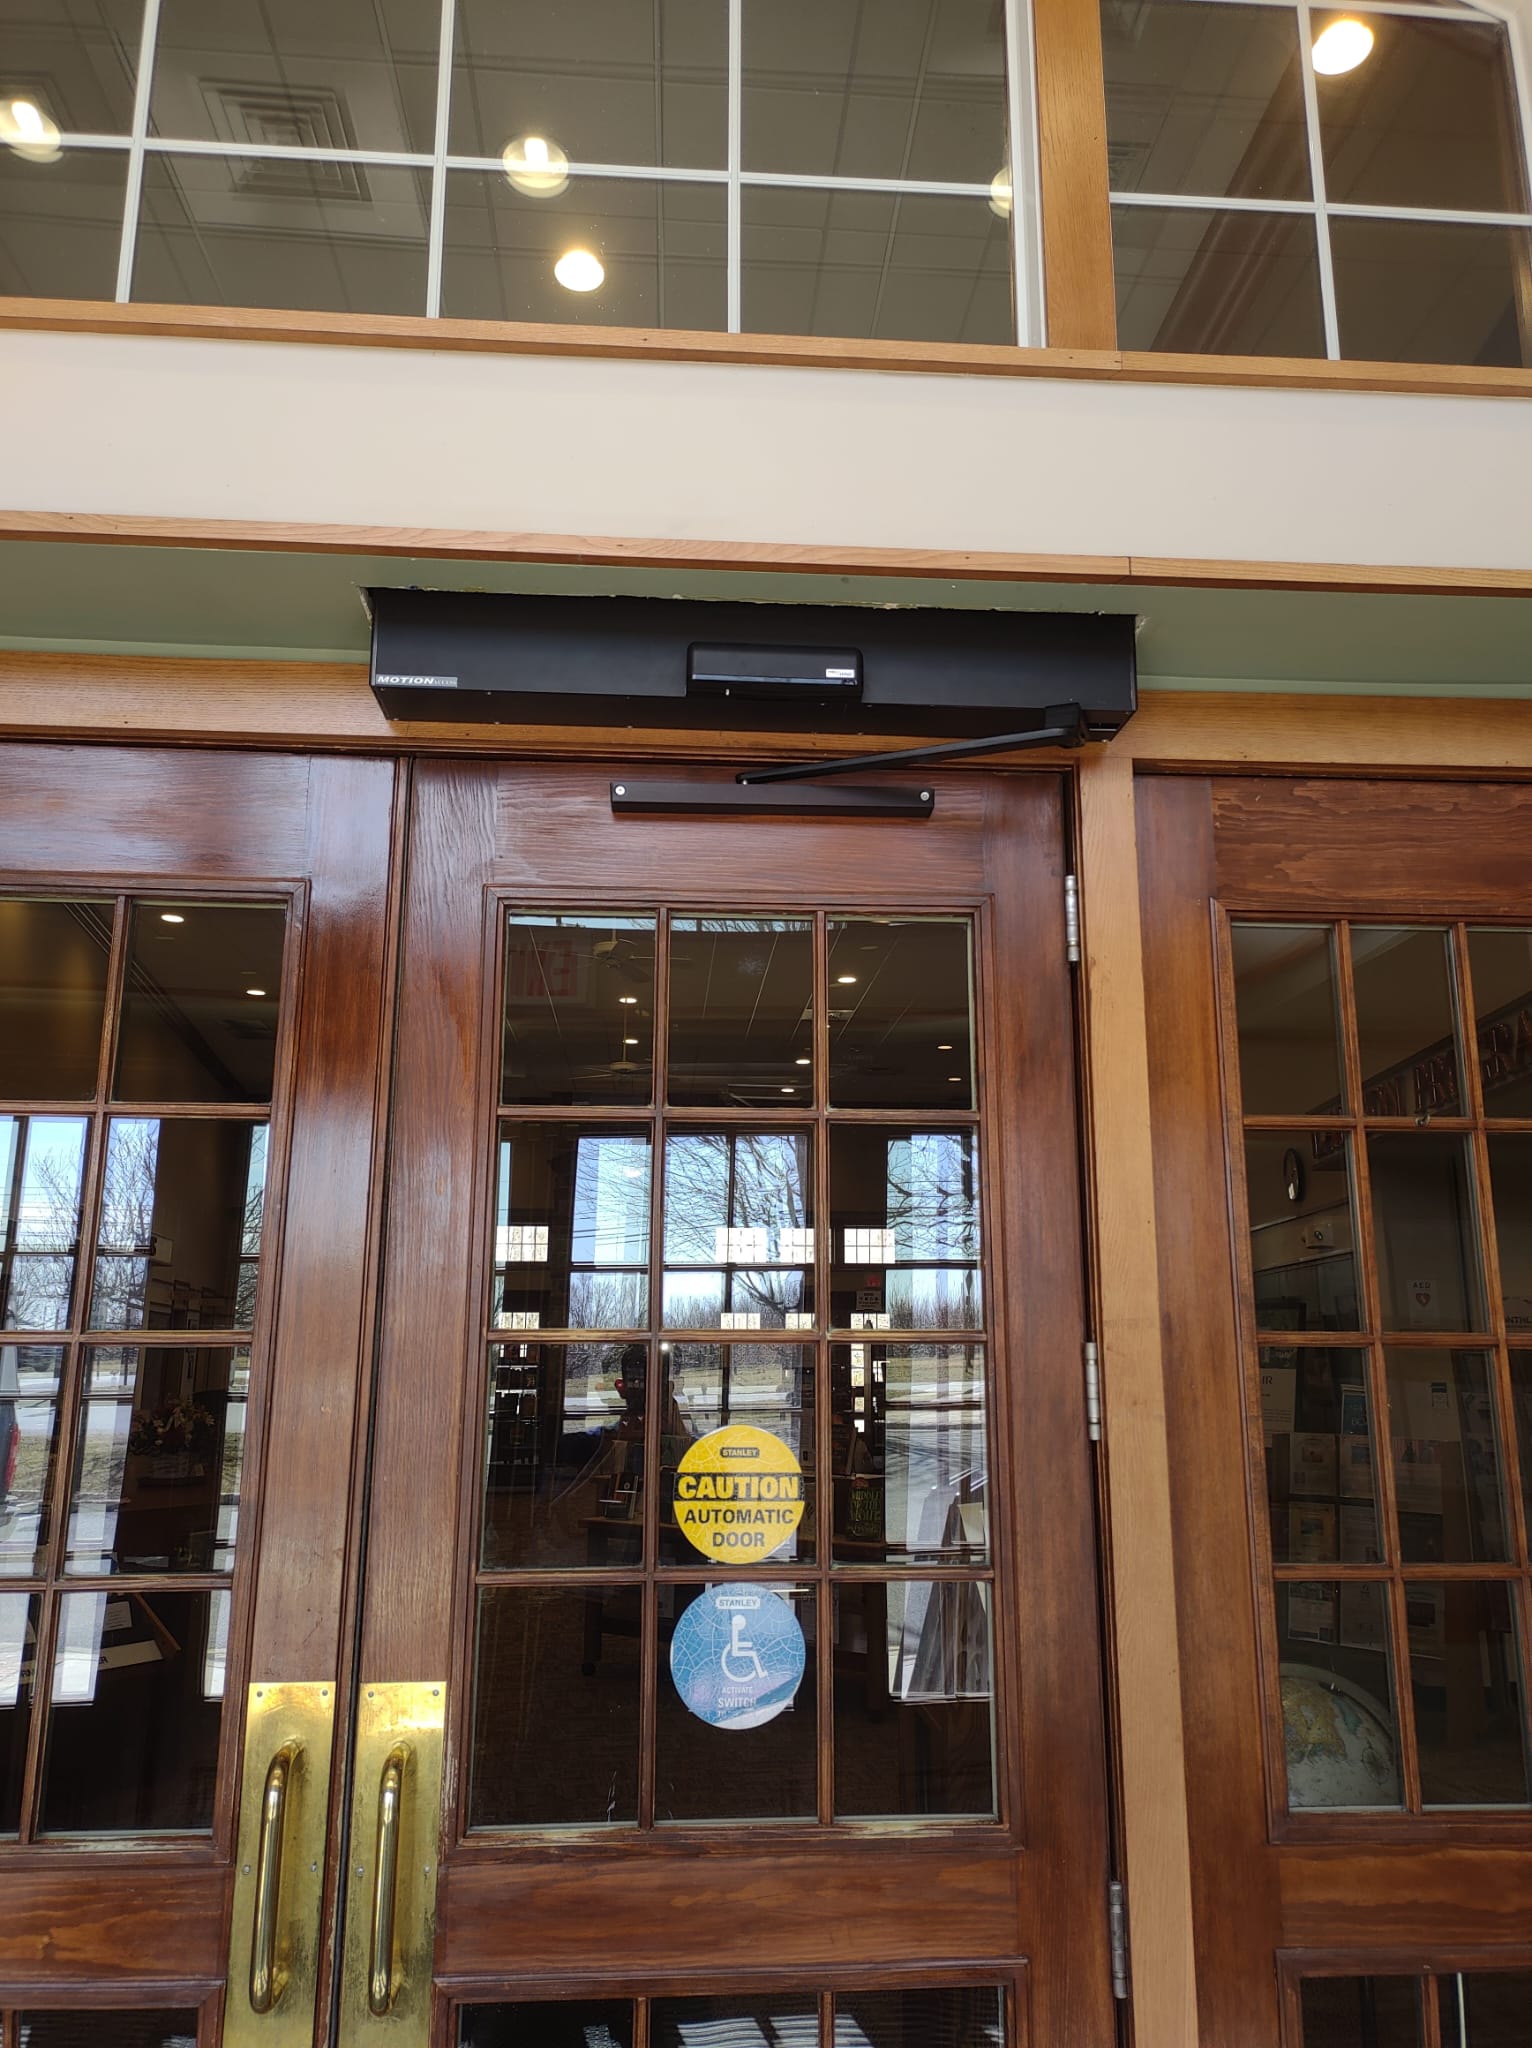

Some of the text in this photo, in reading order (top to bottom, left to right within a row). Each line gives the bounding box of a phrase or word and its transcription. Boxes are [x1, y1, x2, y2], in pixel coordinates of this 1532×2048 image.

[377, 676, 434, 685] MOTION
[722, 1449, 757, 1457] STANLEY
[678, 1475, 798, 1499] CAUTION
[684, 1508, 793, 1524] AUTOMATIC
[712, 1532, 764, 1547] DOOR
[720, 1598, 758, 1607] STANLEY
[722, 1686, 753, 1694] ACTIVATE
[718, 1697, 756, 1708] SWITCH
